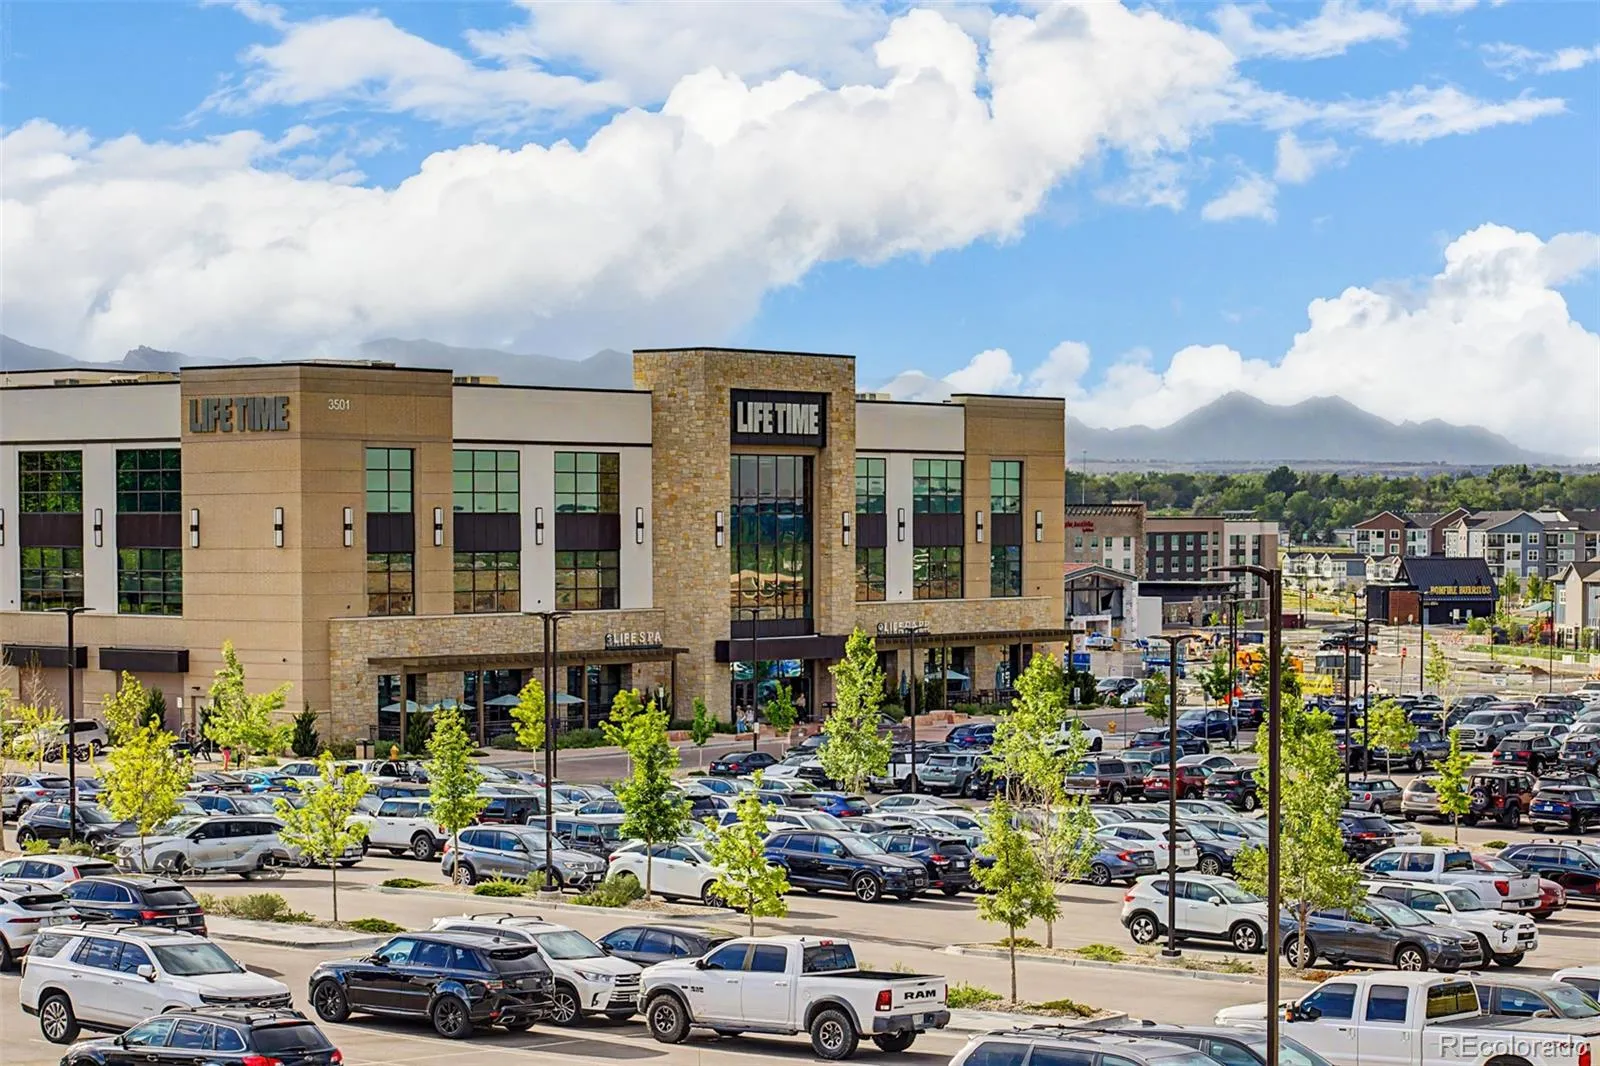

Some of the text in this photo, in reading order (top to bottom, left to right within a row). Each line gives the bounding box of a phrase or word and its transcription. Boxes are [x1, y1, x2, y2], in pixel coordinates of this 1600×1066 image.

[189, 396, 290, 433] LIFE TIME
[327, 399, 350, 411] 3501
[736, 401, 819, 435] LIFE TIME
[904, 990, 936, 1000] RAM
